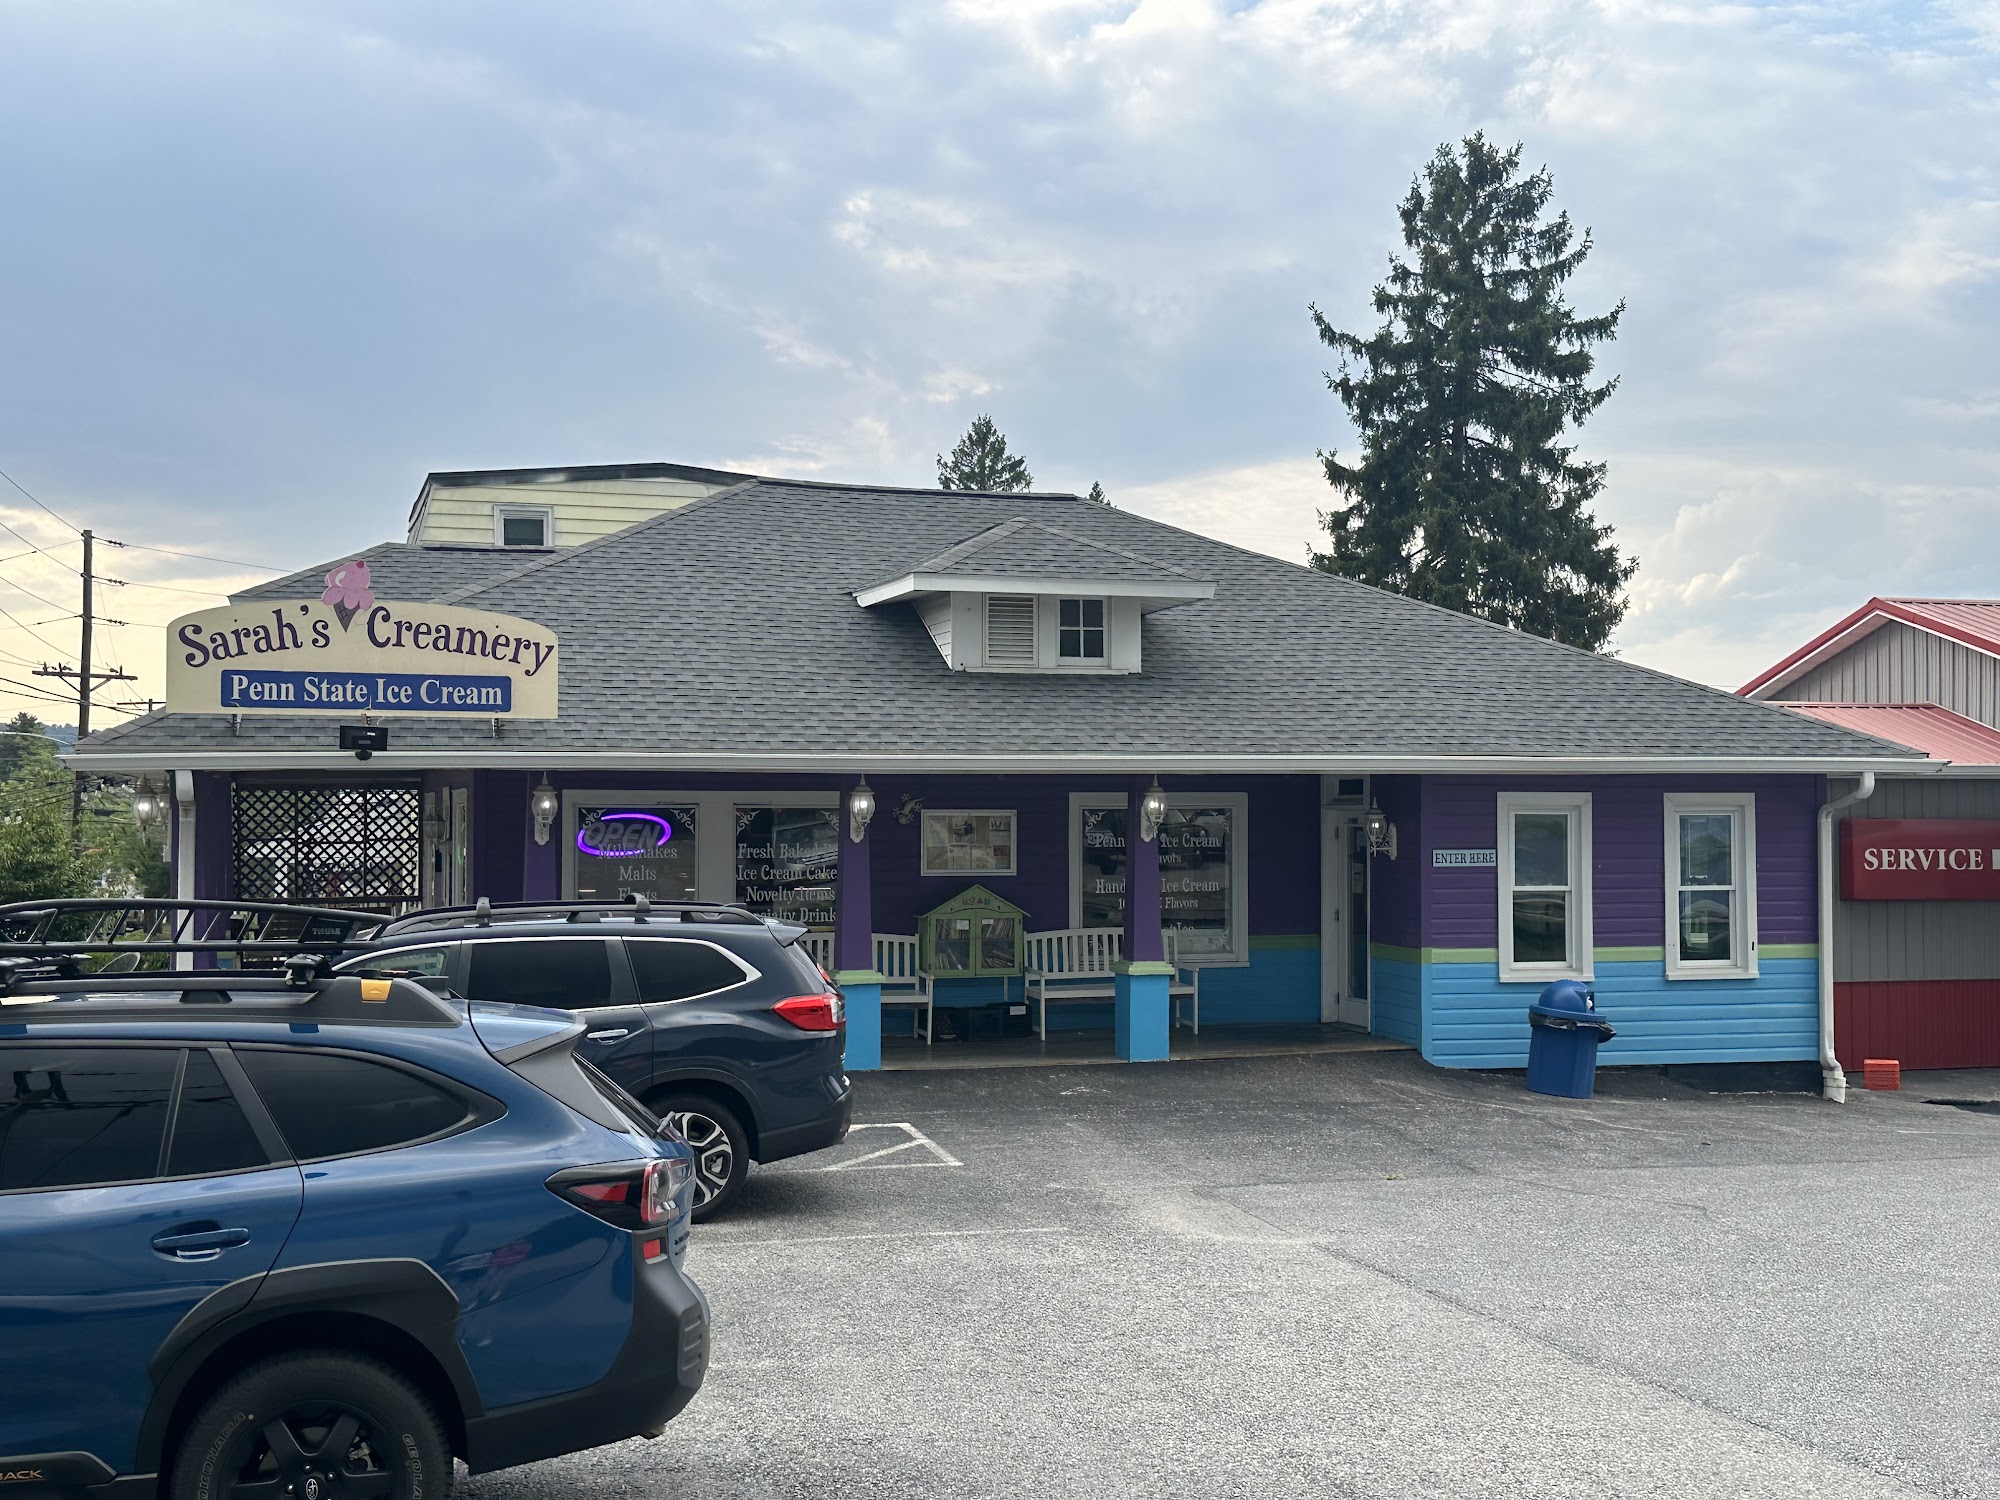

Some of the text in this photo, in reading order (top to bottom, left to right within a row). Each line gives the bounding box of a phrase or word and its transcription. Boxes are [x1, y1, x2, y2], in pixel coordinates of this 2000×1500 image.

[178, 604, 555, 677] Sarah's Creamery
[231, 675, 503, 706] Penn State Ice Cream
[583, 821, 661, 849] OPEN
[1095, 833, 1126, 848] Penn
[1182, 832, 1220, 848] Cream
[737, 843, 775, 859] Fresh
[1434, 852, 1495, 864] ENTER HERE
[1863, 848, 1984, 871] SERVICE
[618, 865, 657, 881] Malts
[737, 864, 758, 880] Ice
[760, 864, 802, 880] Cream
[1161, 878, 1180, 892] Ice
[1182, 878, 1220, 892] Cream
[746, 886, 795, 904] Novelty
[1165, 897, 1199, 909] Flavors
